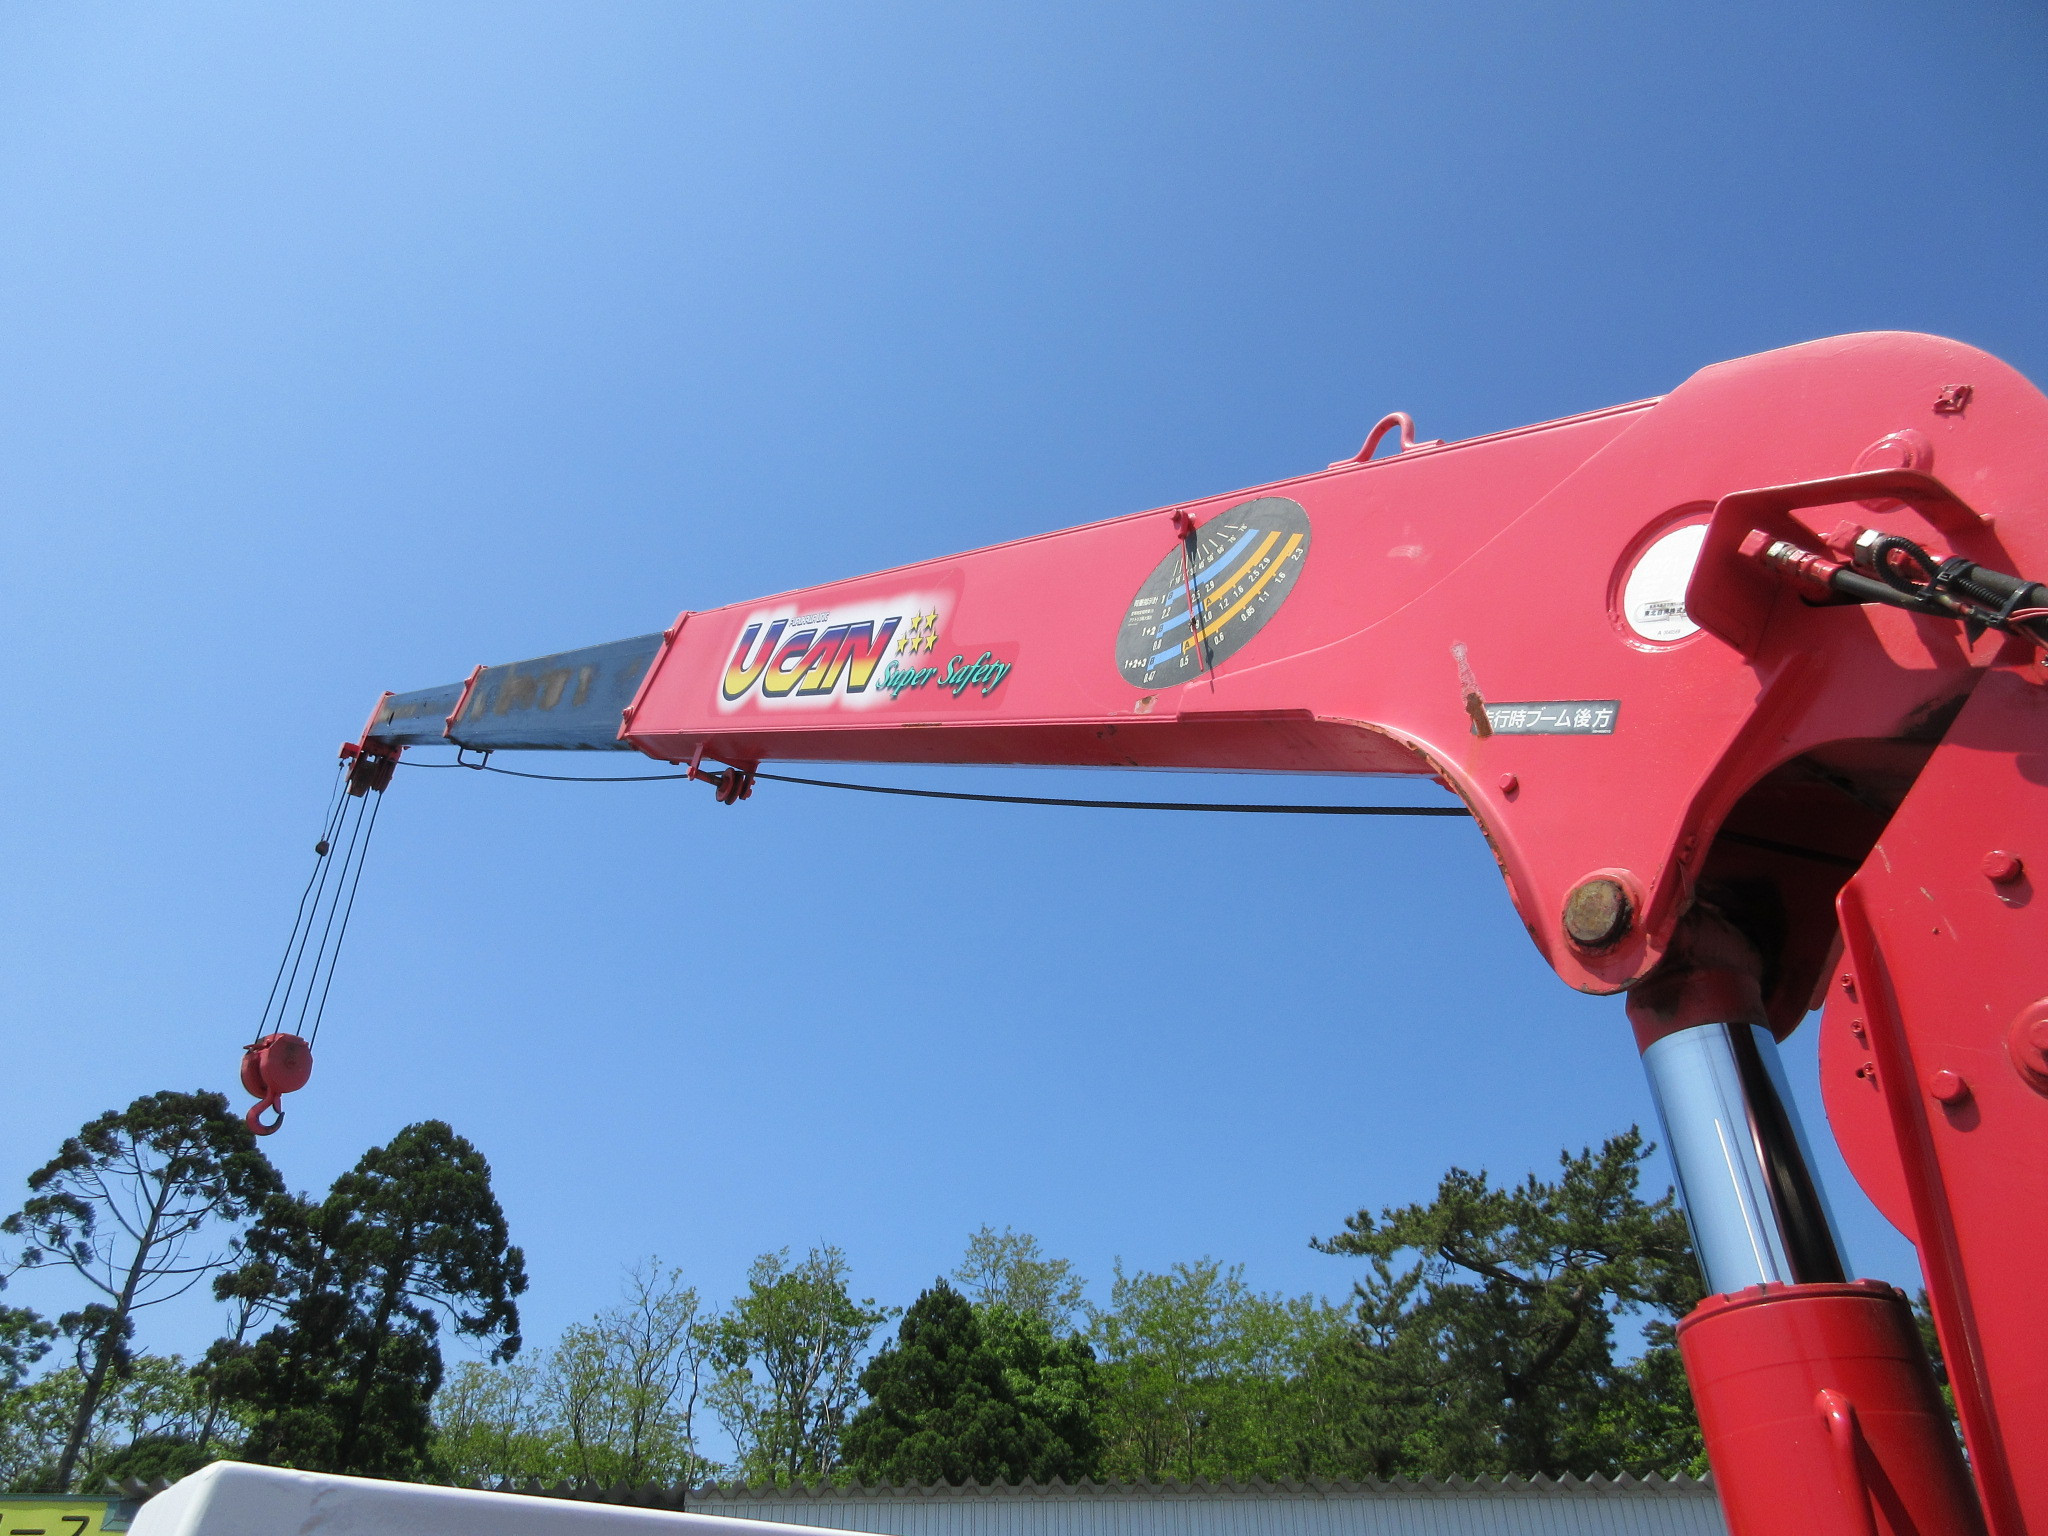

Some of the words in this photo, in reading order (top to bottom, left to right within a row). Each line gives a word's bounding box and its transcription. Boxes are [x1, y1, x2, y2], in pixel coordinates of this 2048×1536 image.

[1180, 655, 1189, 668] 0.5
[1214, 632, 1224, 645] 0.6
[1240, 605, 1255, 622] 0.85
[1258, 591, 1269, 603] 1.1
[1274, 571, 1286, 584] 1.6
[1291, 548, 1303, 561] 2.3
[1203, 611, 1213, 623] 1.0
[1219, 598, 1229, 610] 1.2
[1233, 585, 1244, 597] 1.6
[1248, 569, 1260, 582] 2.5
[1259, 557, 1271, 570] 2.9
[1205, 580, 1215, 592] 2.9
[1142, 626, 1157, 637] 1+2
[723, 616, 902, 701] UCAN
[876, 660, 938, 698] Super
[938, 651, 1011, 694] Safety
[1124, 658, 1147, 669] 1+2+3
